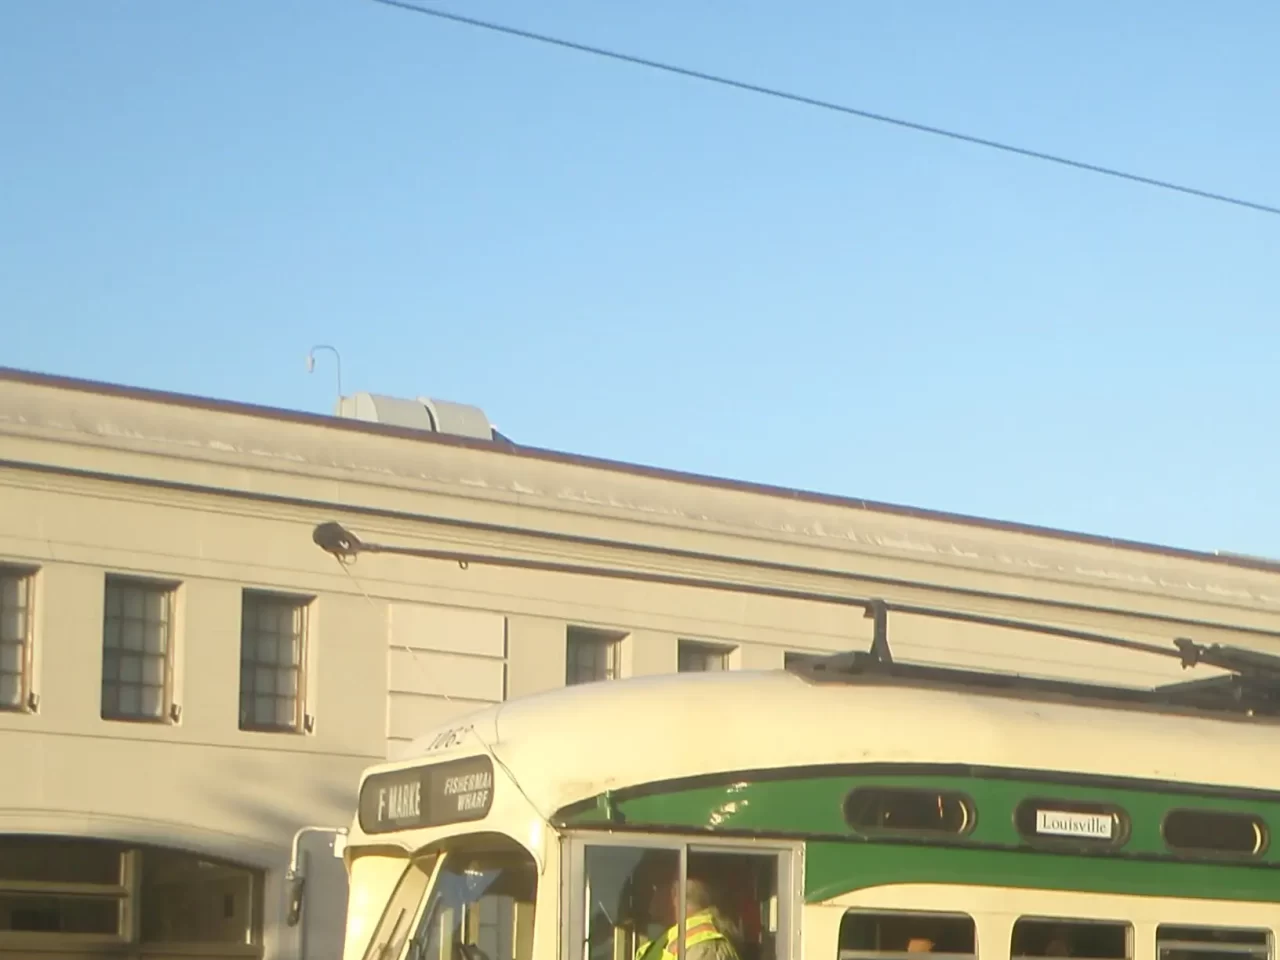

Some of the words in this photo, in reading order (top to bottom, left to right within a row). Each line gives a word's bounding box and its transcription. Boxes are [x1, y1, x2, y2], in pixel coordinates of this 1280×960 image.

[378, 788, 387, 821] F
[457, 790, 489, 812] WHARF
[1042, 813, 1107, 834] Louisville
